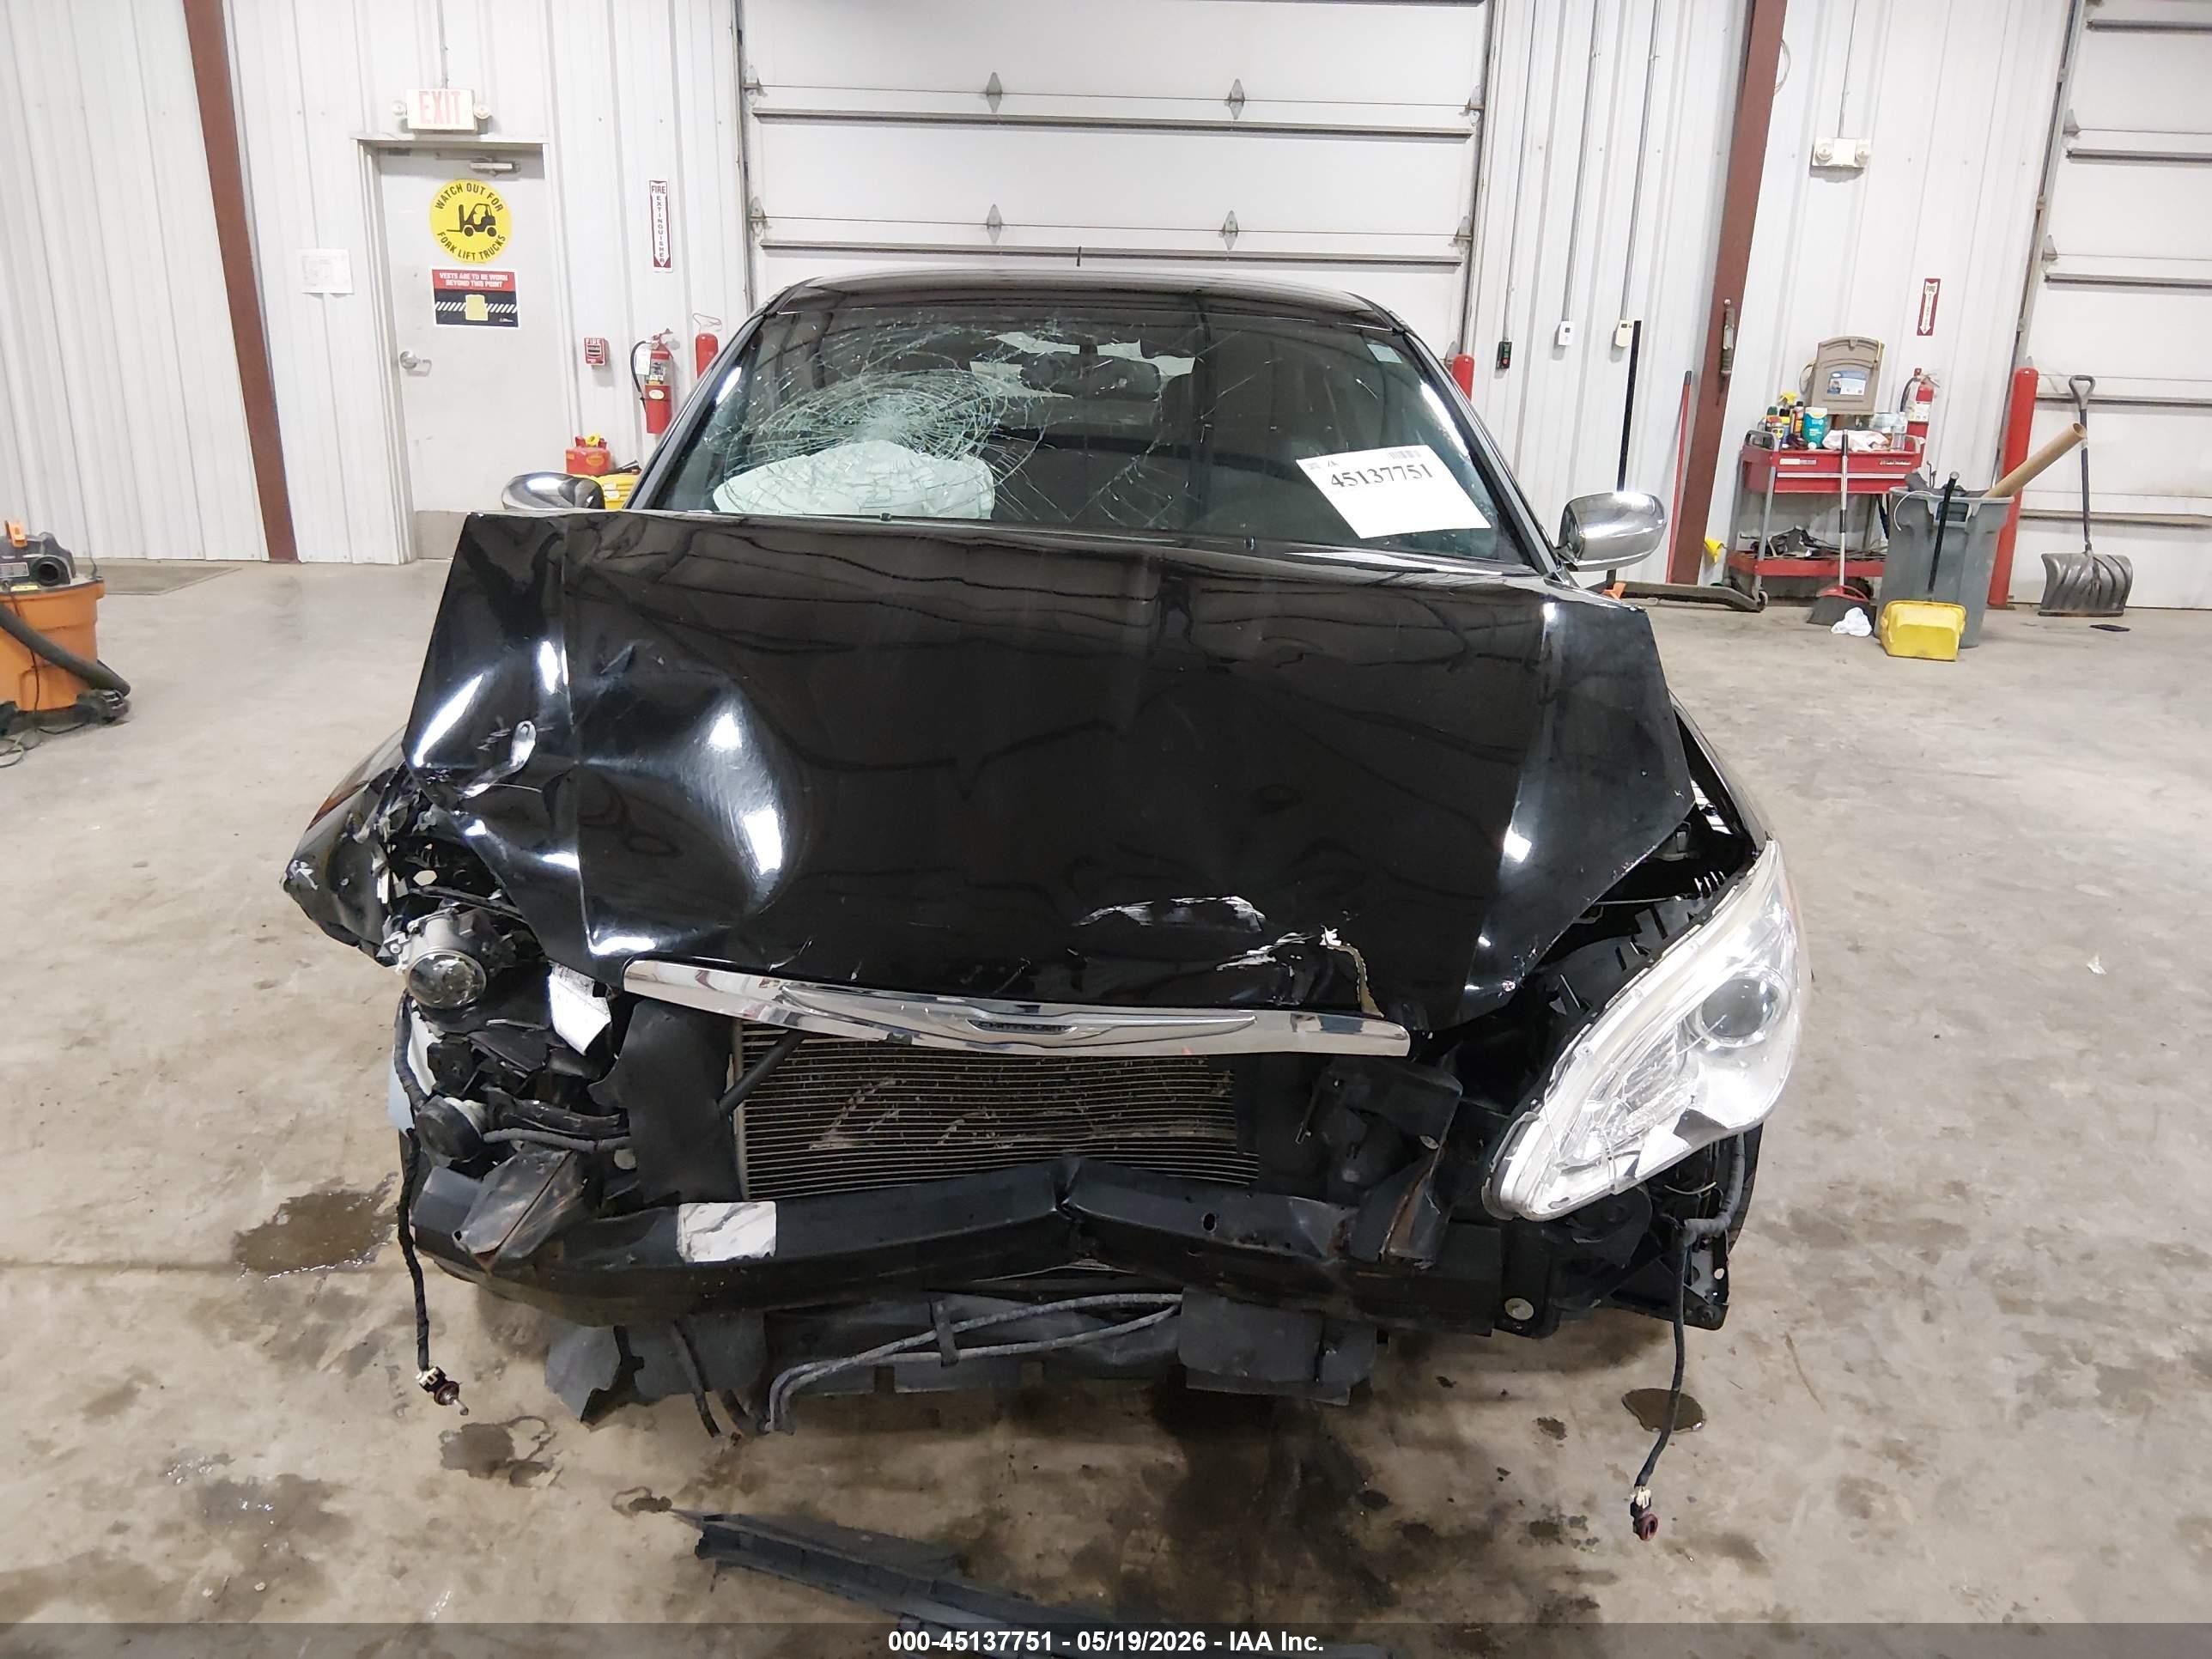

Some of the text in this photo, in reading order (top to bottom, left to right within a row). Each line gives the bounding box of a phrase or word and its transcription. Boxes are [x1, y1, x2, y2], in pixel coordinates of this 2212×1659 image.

[418, 91, 460, 124] EXIT
[434, 182, 504, 212] WATCH OUT FOR
[651, 185, 666, 194] FIRE
[656, 196, 665, 263] EXTINGUISHER
[436, 231, 507, 261] FORK LIFT TRUCKS
[1331, 464, 1433, 488] 45137751
